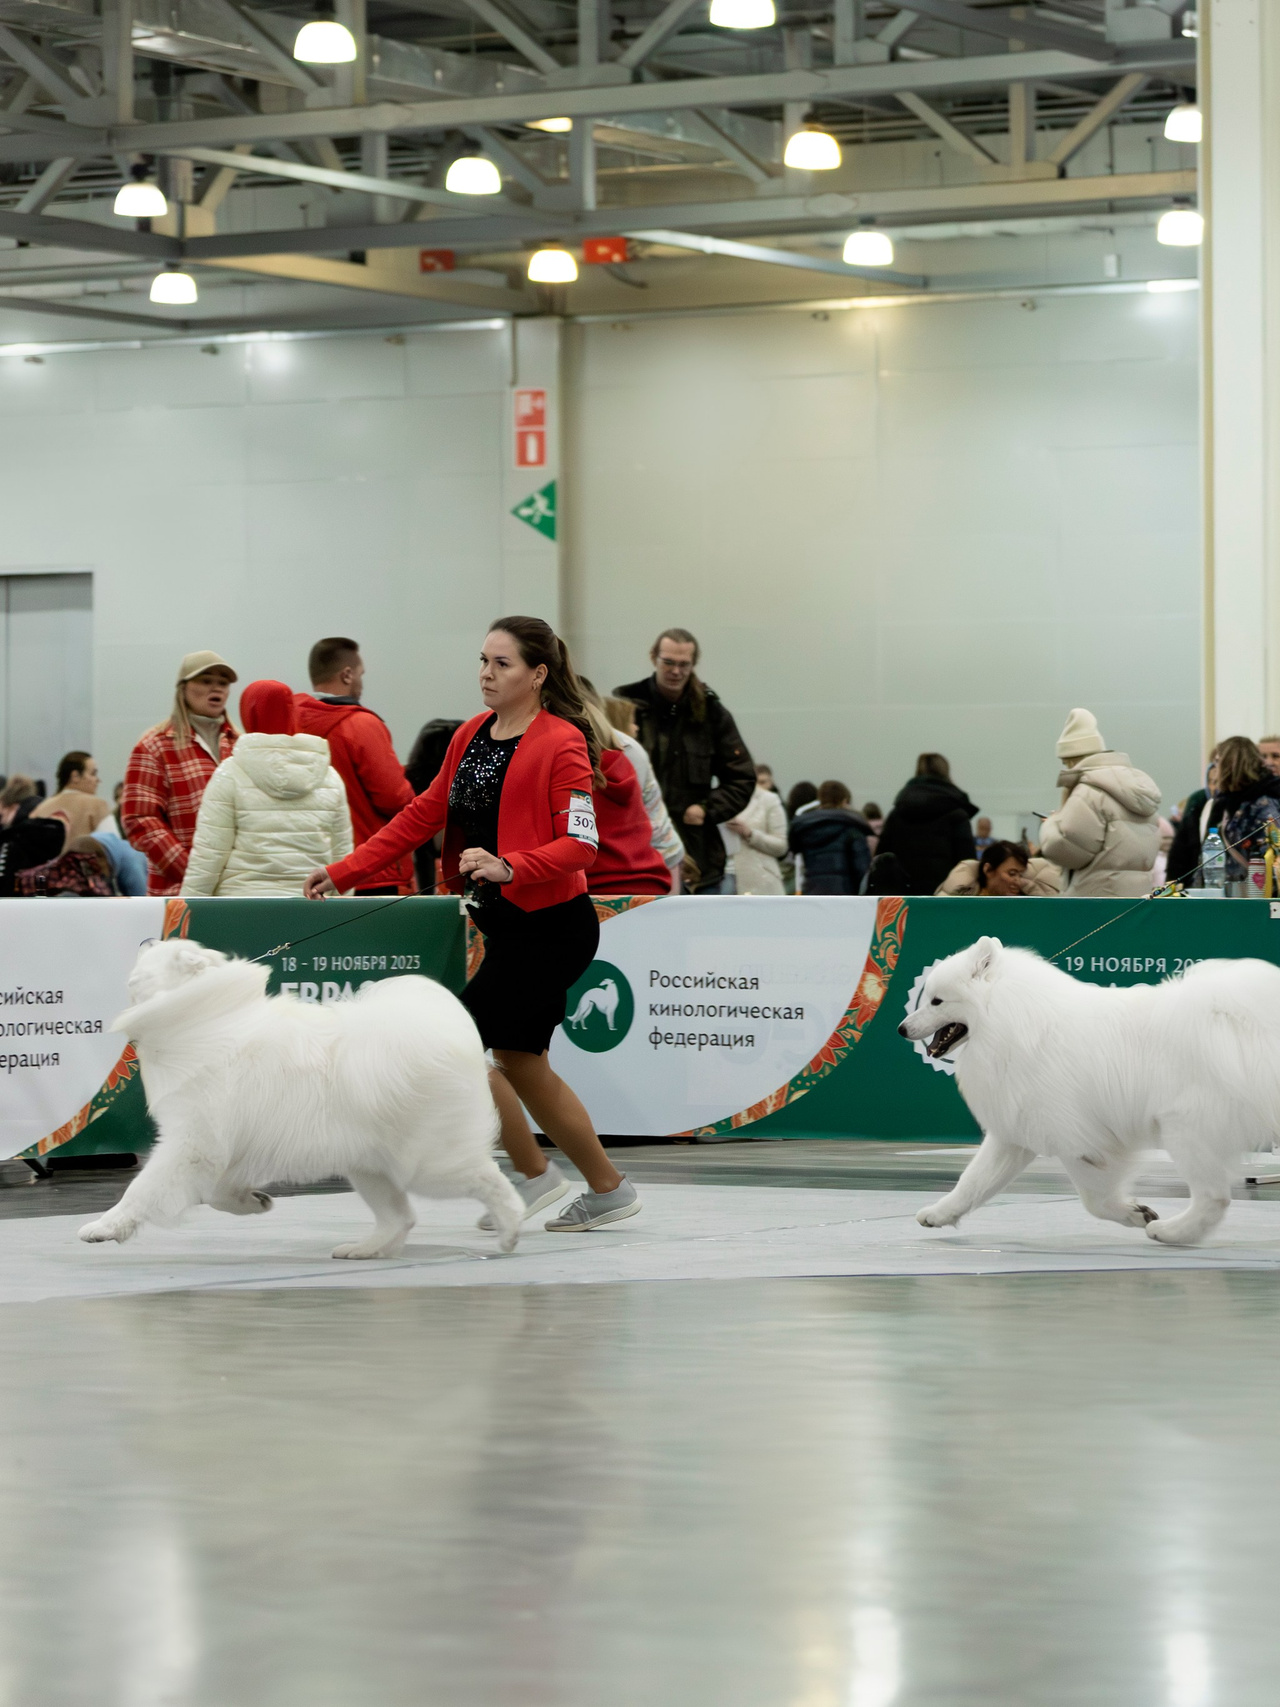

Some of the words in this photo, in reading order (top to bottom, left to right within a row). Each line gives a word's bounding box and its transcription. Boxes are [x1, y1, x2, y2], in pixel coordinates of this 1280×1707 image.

[281, 957, 297, 972] 18
[312, 956, 328, 971] 19
[331, 955, 387, 971] НОЯБРЯ
[390, 954, 421, 970] 2023
[1065, 956, 1085, 972] 19
[1091, 957, 1167, 973] НОЯБРЯ
[649, 969, 760, 990] Российская
[649, 1003, 805, 1020] кинологическая
[648, 1025, 755, 1051] федерация
